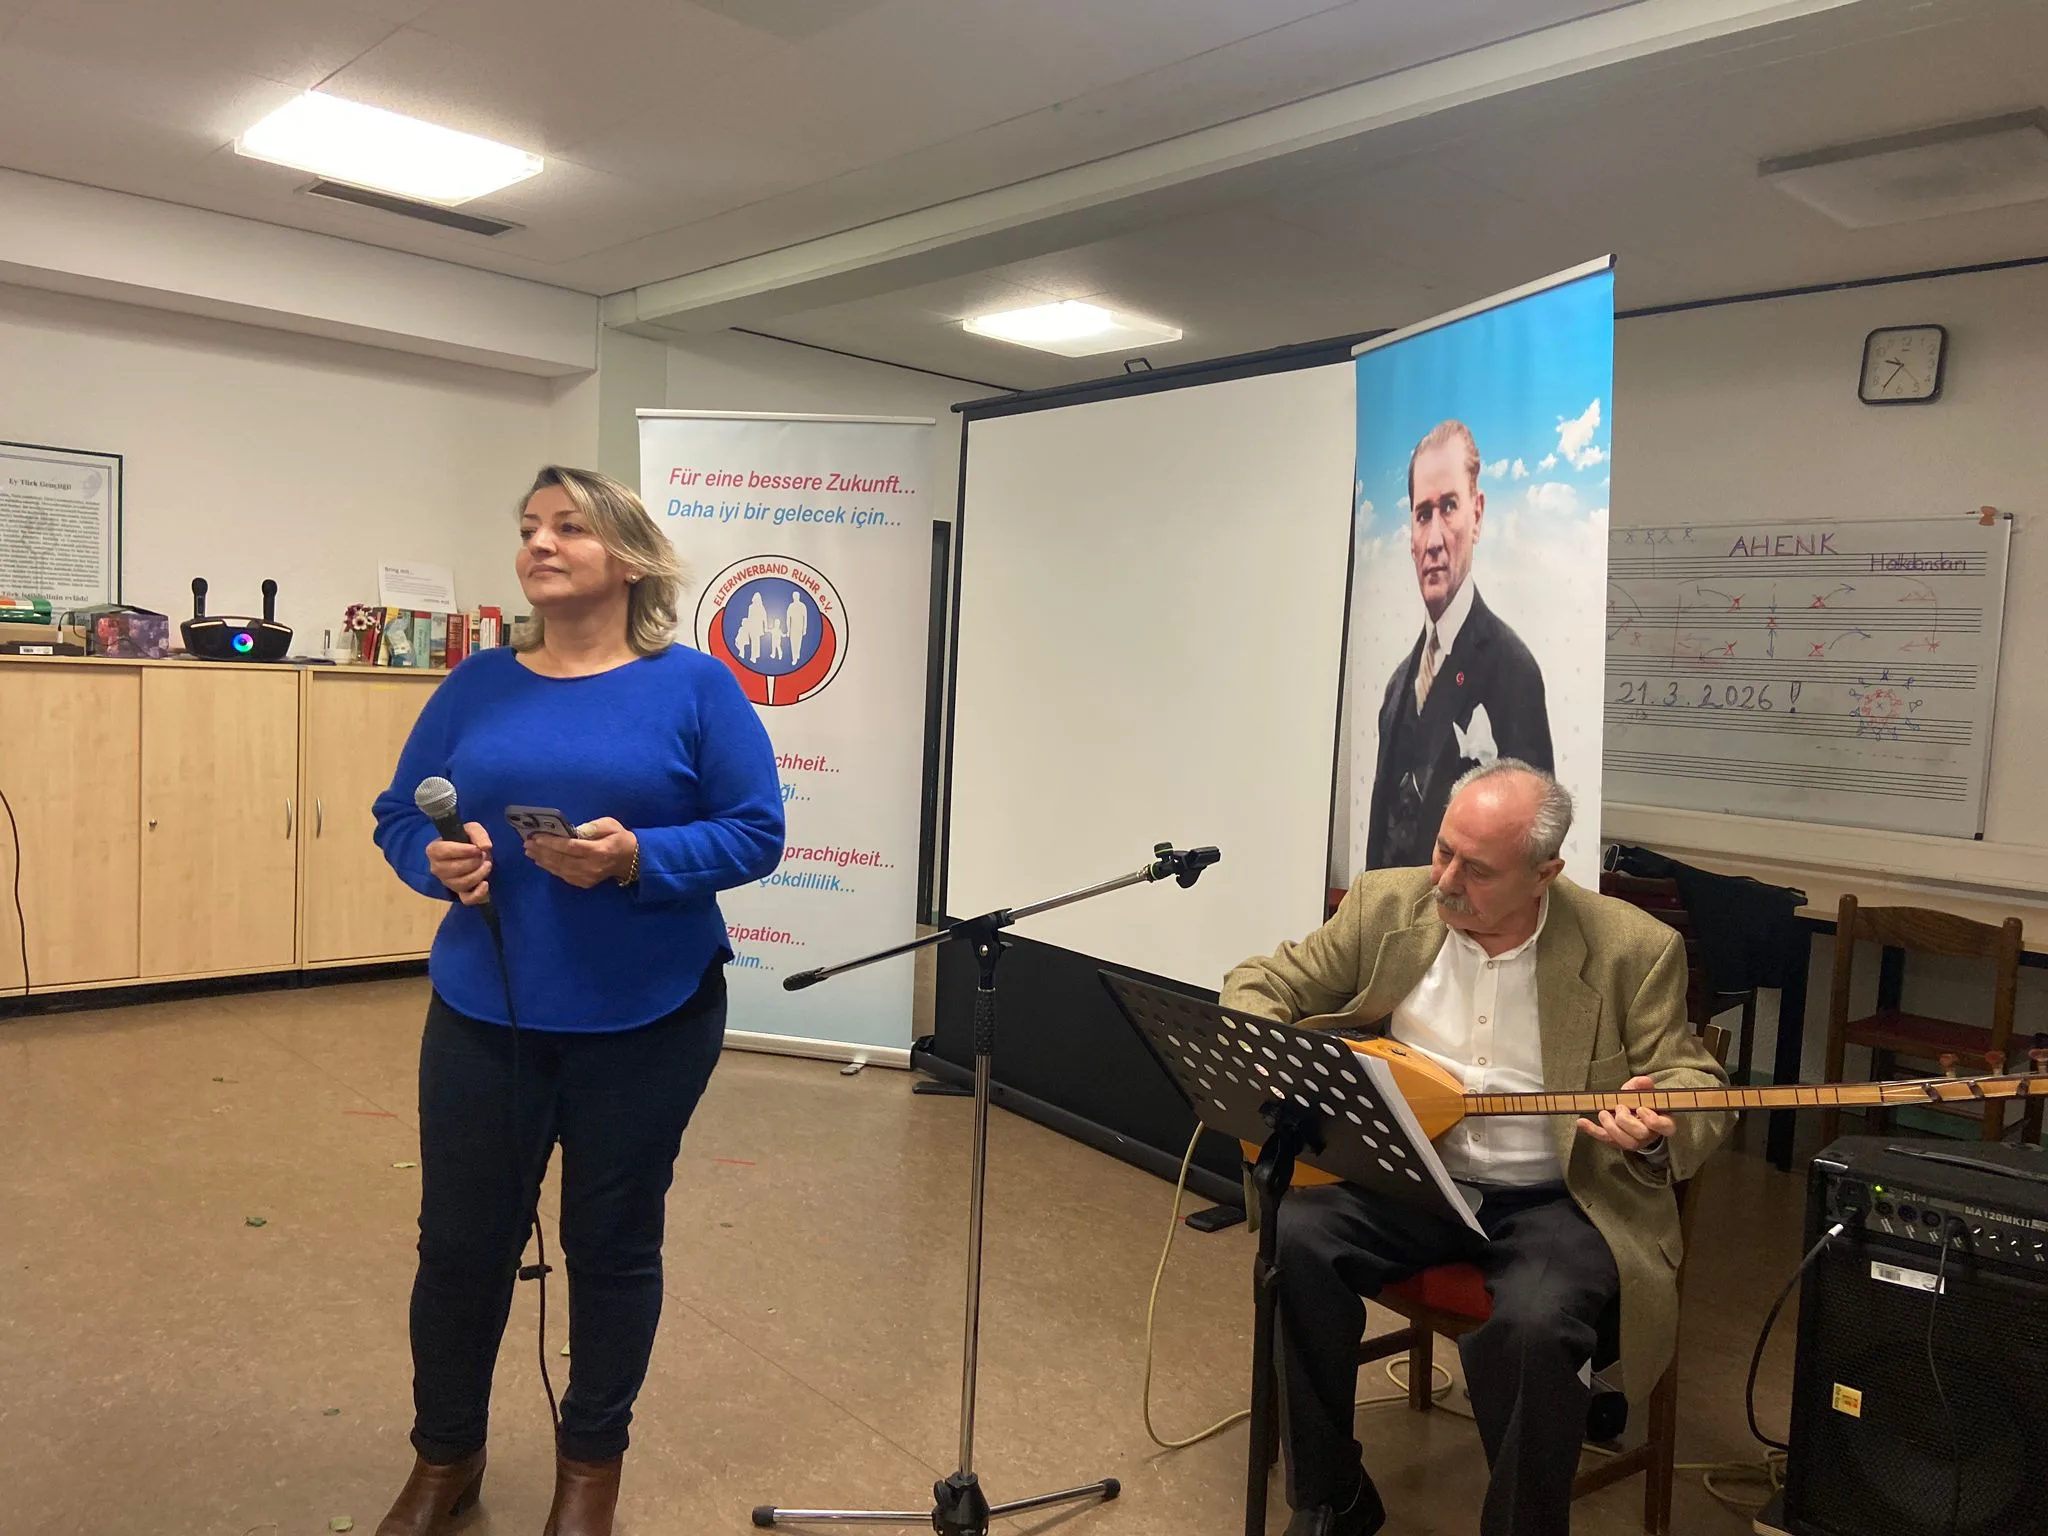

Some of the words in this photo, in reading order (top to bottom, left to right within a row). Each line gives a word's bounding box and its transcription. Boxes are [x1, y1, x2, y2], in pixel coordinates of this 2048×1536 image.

[669, 468, 701, 486] Für
[705, 470, 743, 488] eine
[749, 471, 823, 490] bessere
[825, 473, 916, 494] Zukunft...
[667, 499, 713, 518] Daha
[718, 502, 740, 523] iyi
[743, 503, 770, 521] bir
[772, 505, 846, 526] gelecek
[850, 507, 901, 529] için...
[1728, 532, 1839, 557] AHENK
[713, 563, 789, 607] ELTERNVERBAND
[791, 568, 821, 594] RUHR
[774, 753, 840, 773] chheit...
[783, 846, 895, 869] prachigkeit...
[726, 923, 805, 946] zipation...
